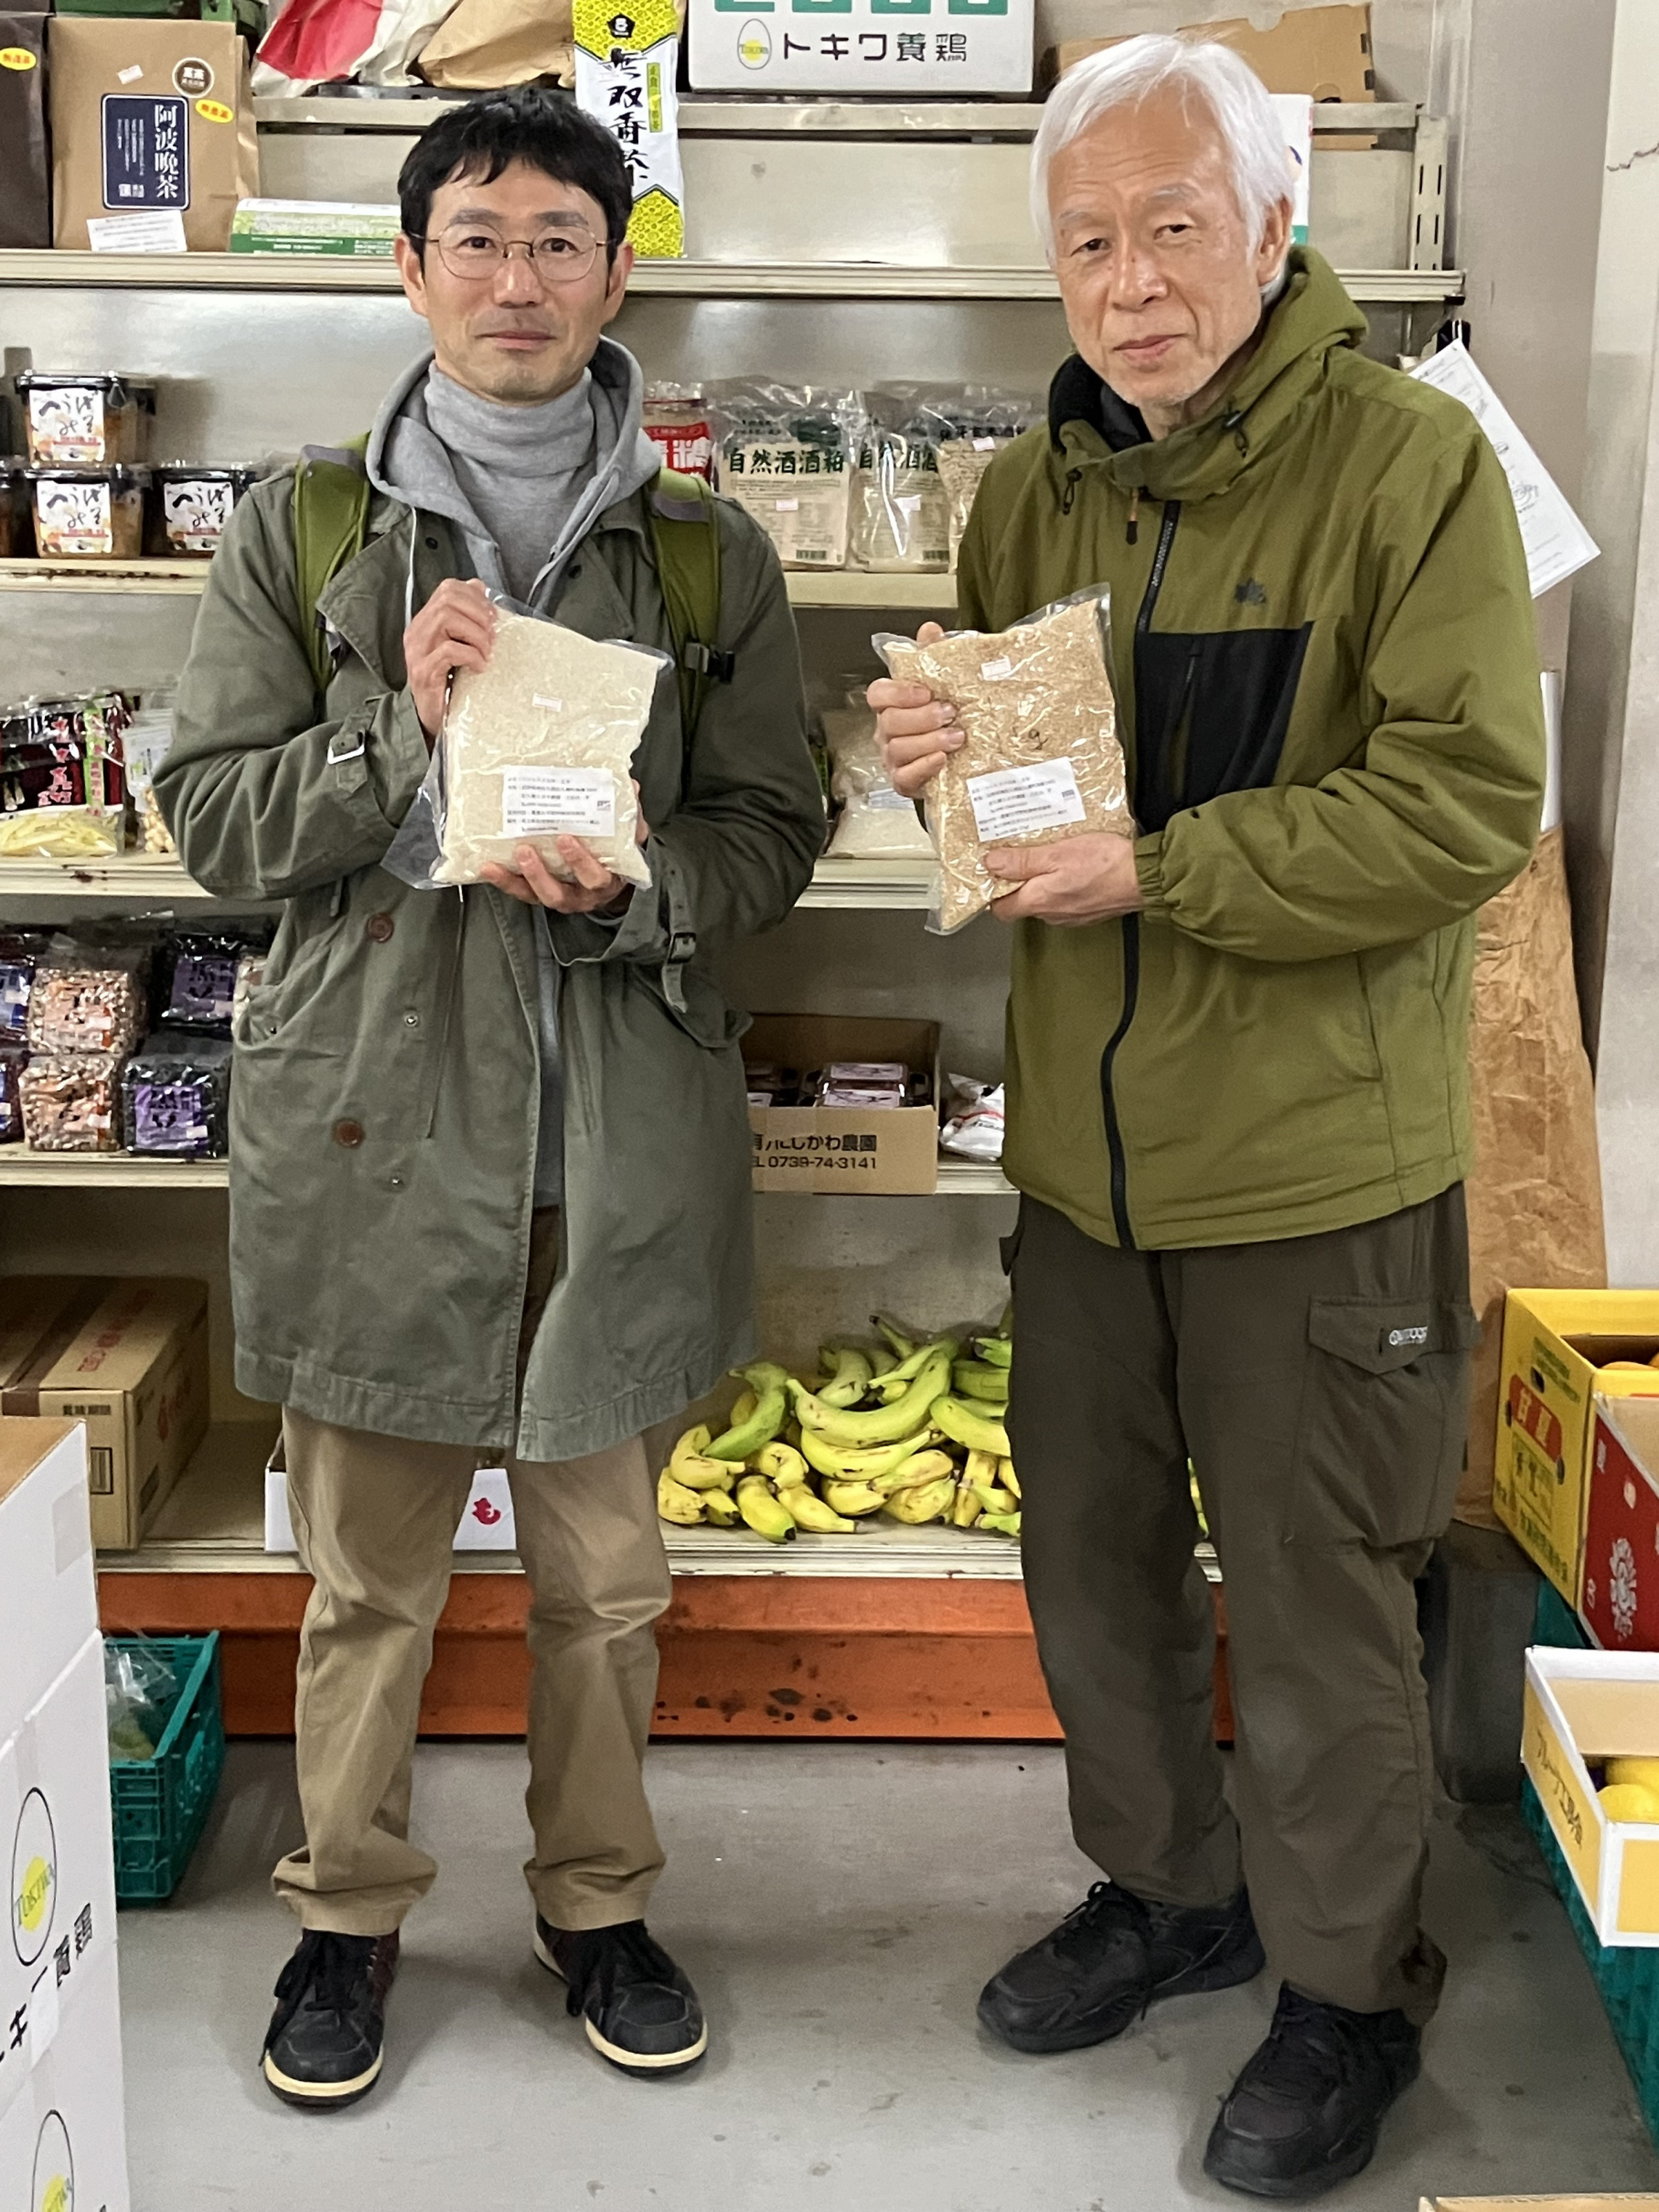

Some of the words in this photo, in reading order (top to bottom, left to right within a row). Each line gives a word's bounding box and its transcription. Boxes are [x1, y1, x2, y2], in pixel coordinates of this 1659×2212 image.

[783, 32, 967, 62] トキワ養鶏
[154, 104, 179, 199] 阿波晩茶
[730, 447, 844, 474] 自然酒酒粕
[768, 1156, 877, 1169] 0739-74-3141
